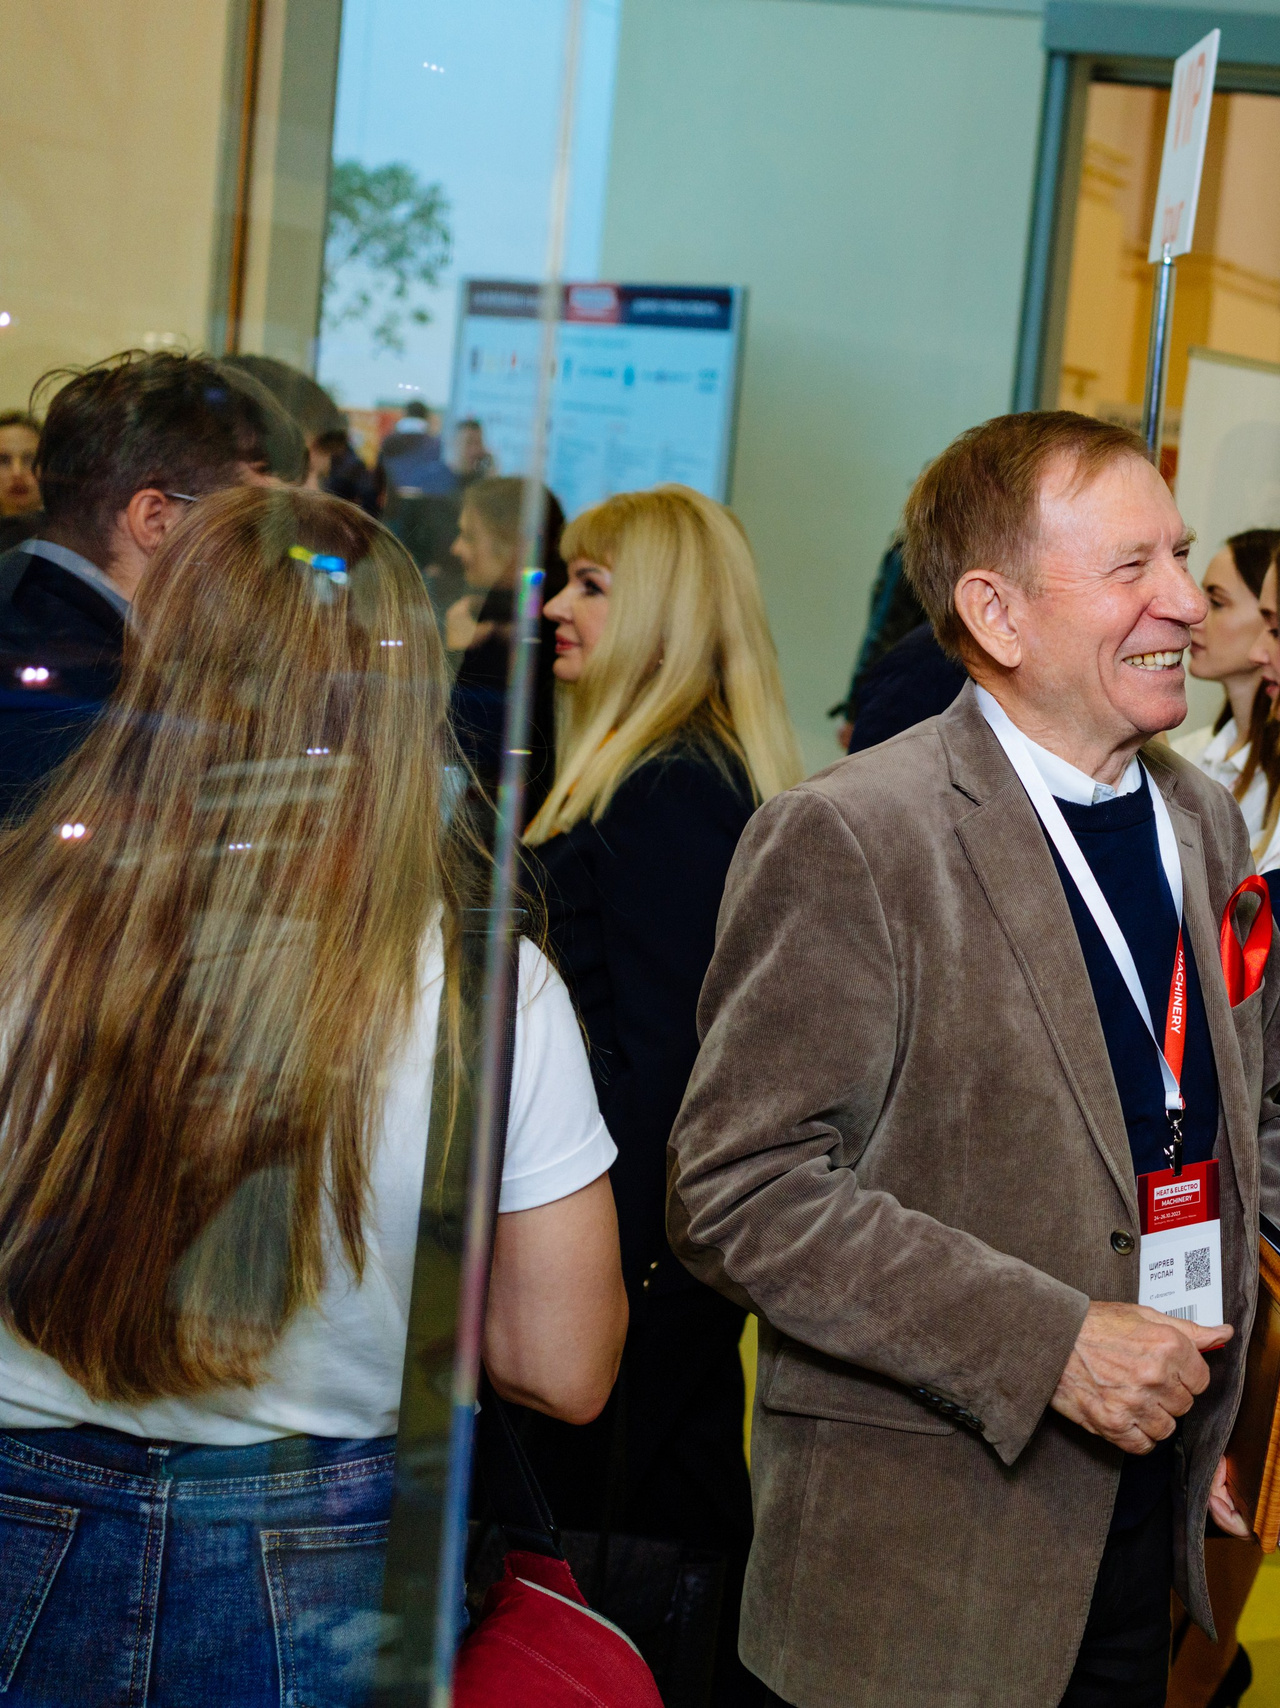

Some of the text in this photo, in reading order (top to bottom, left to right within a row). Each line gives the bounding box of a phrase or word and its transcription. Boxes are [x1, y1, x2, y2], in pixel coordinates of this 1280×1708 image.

[1170, 950, 1184, 1034] MACHINERY
[1156, 1188, 1170, 1197] HEAT
[1174, 1182, 1199, 1193] ELECTRO
[1161, 1195, 1193, 1207] MACHINERY
[1148, 1257, 1175, 1271] ШИРЯЕВ
[1149, 1269, 1174, 1281] РУСЛАН
